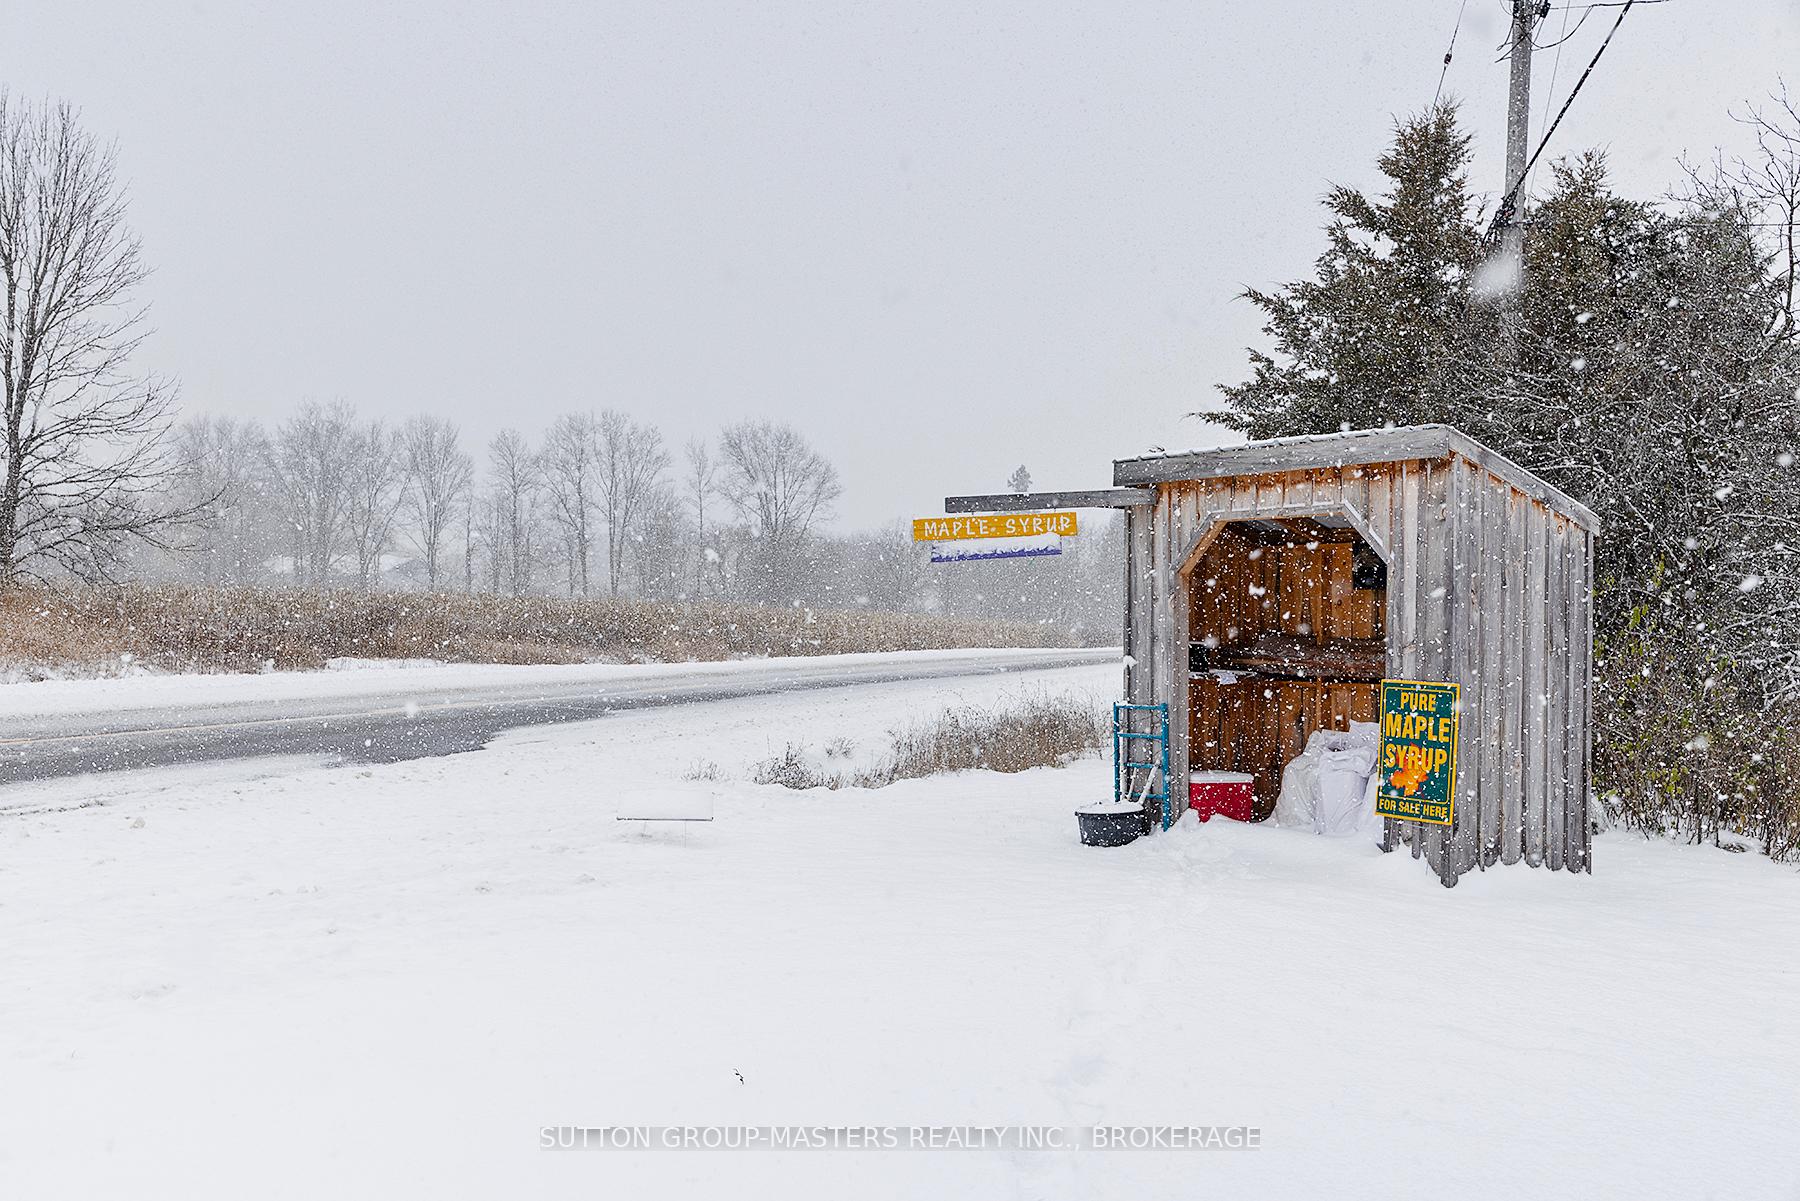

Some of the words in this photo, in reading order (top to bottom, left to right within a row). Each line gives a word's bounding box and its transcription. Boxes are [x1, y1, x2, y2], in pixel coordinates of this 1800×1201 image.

[1005, 516, 1071, 534] SYRUP
[1400, 692, 1437, 712] PURE
[1385, 713, 1450, 743] MAPLE
[1385, 743, 1448, 773] SYRUP
[1379, 799, 1397, 812] FOR
[1398, 802, 1421, 815] SALE
[1423, 803, 1449, 818] HERE
